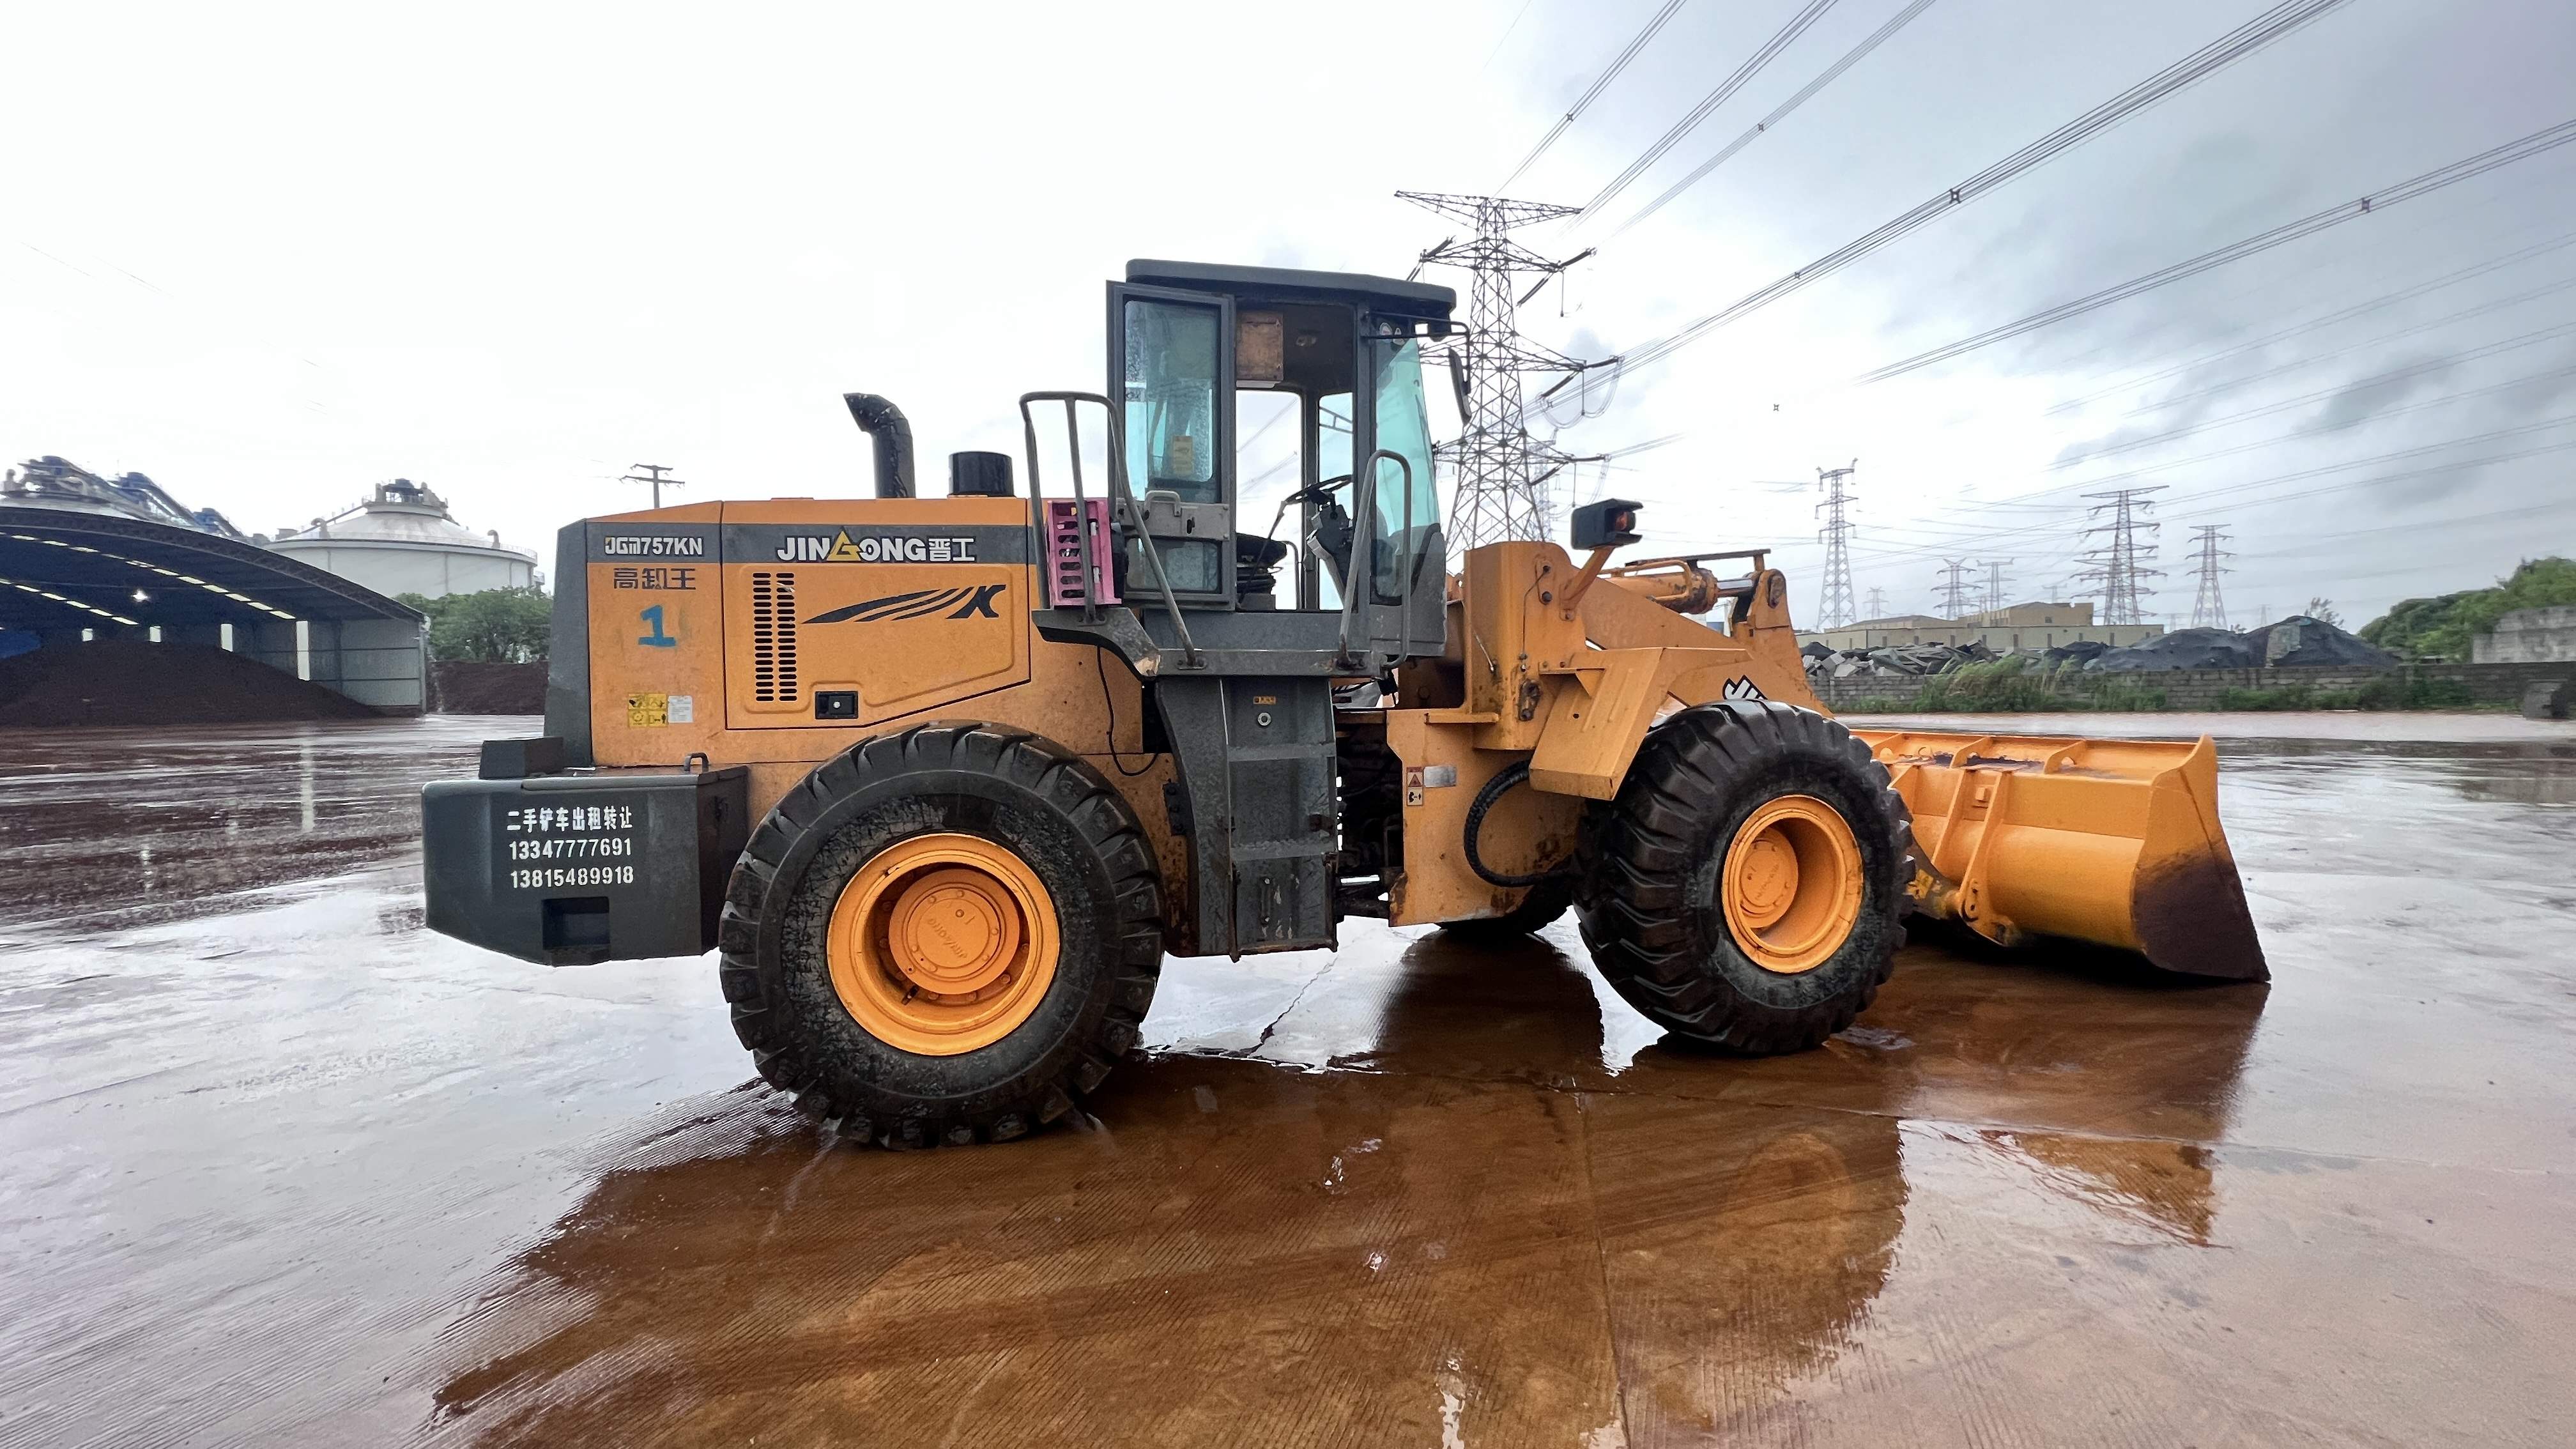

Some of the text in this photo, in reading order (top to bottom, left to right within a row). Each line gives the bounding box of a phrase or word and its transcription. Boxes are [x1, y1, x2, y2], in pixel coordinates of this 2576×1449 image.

[777, 531, 975, 562] JINGONG 晋工
[613, 568, 696, 590] 高卸王
[638, 604, 675, 647] 1
[507, 806, 632, 833] 二手铲车出租转让
[509, 838, 631, 860] 13347777691
[510, 866, 634, 889] 13815489918
